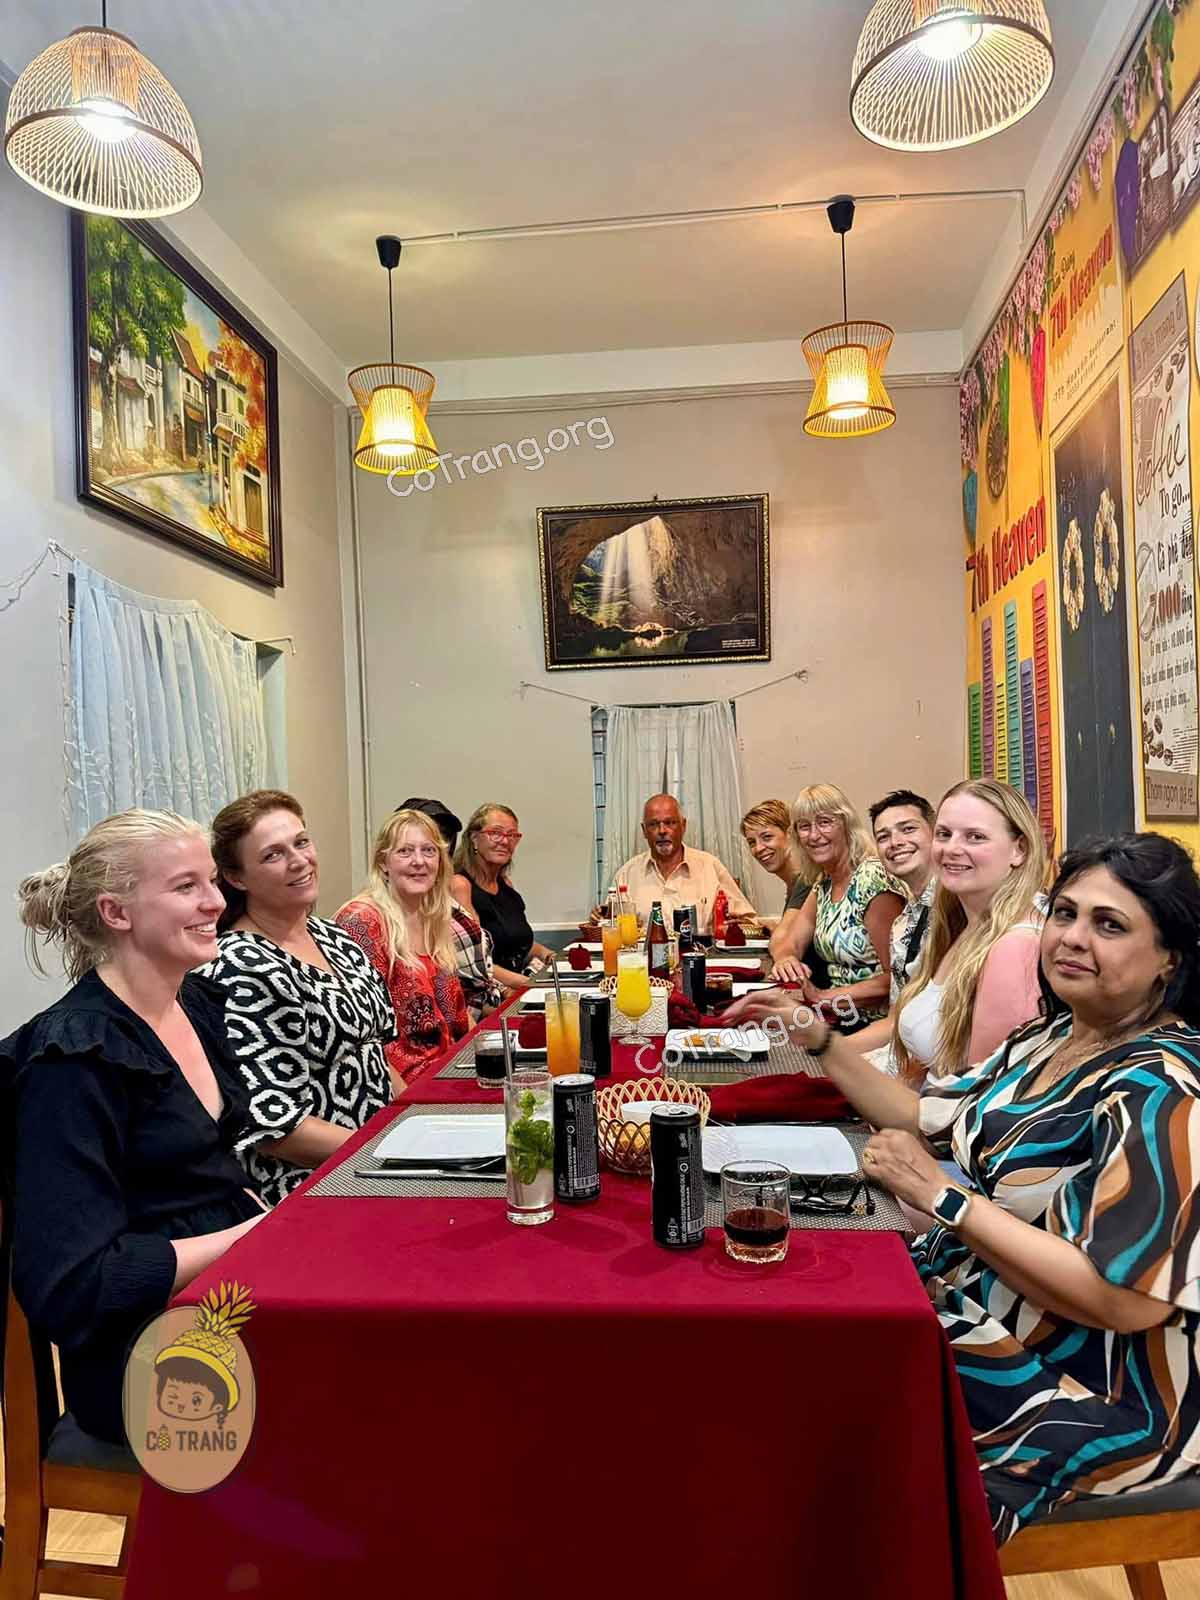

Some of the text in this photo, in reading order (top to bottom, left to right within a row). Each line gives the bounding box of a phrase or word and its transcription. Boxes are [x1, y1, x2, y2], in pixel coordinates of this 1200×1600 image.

[1050, 223, 1113, 348] 7th Heaven
[966, 495, 1047, 613] 7th Heaven
[1160, 487, 1169, 518] To
